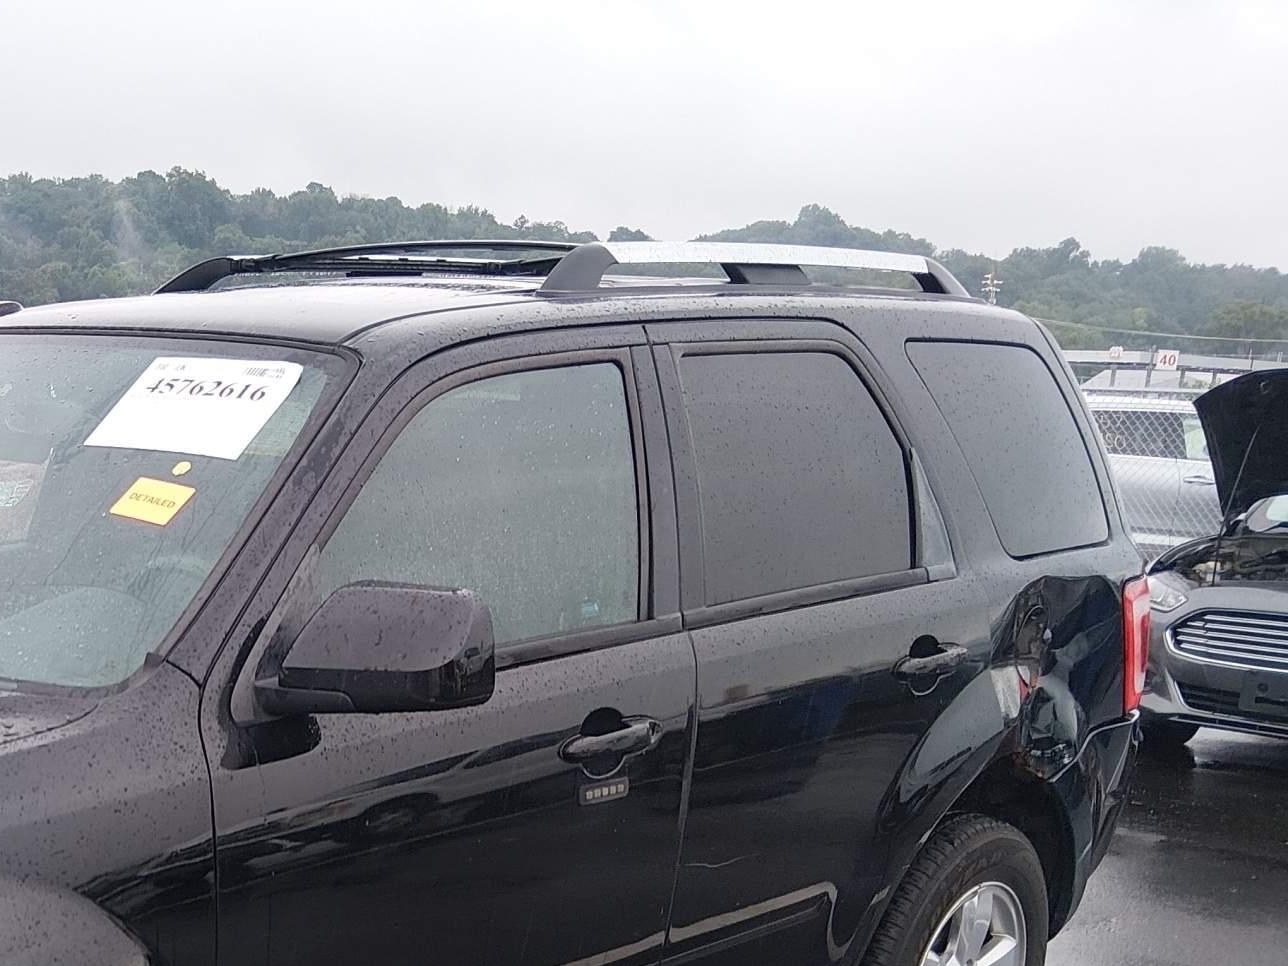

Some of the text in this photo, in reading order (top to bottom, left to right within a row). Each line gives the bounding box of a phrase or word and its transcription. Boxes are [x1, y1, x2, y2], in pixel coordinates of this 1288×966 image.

[1159, 354, 1177, 366] 40
[146, 378, 271, 401] 45762616
[129, 492, 176, 509] DETAILED
